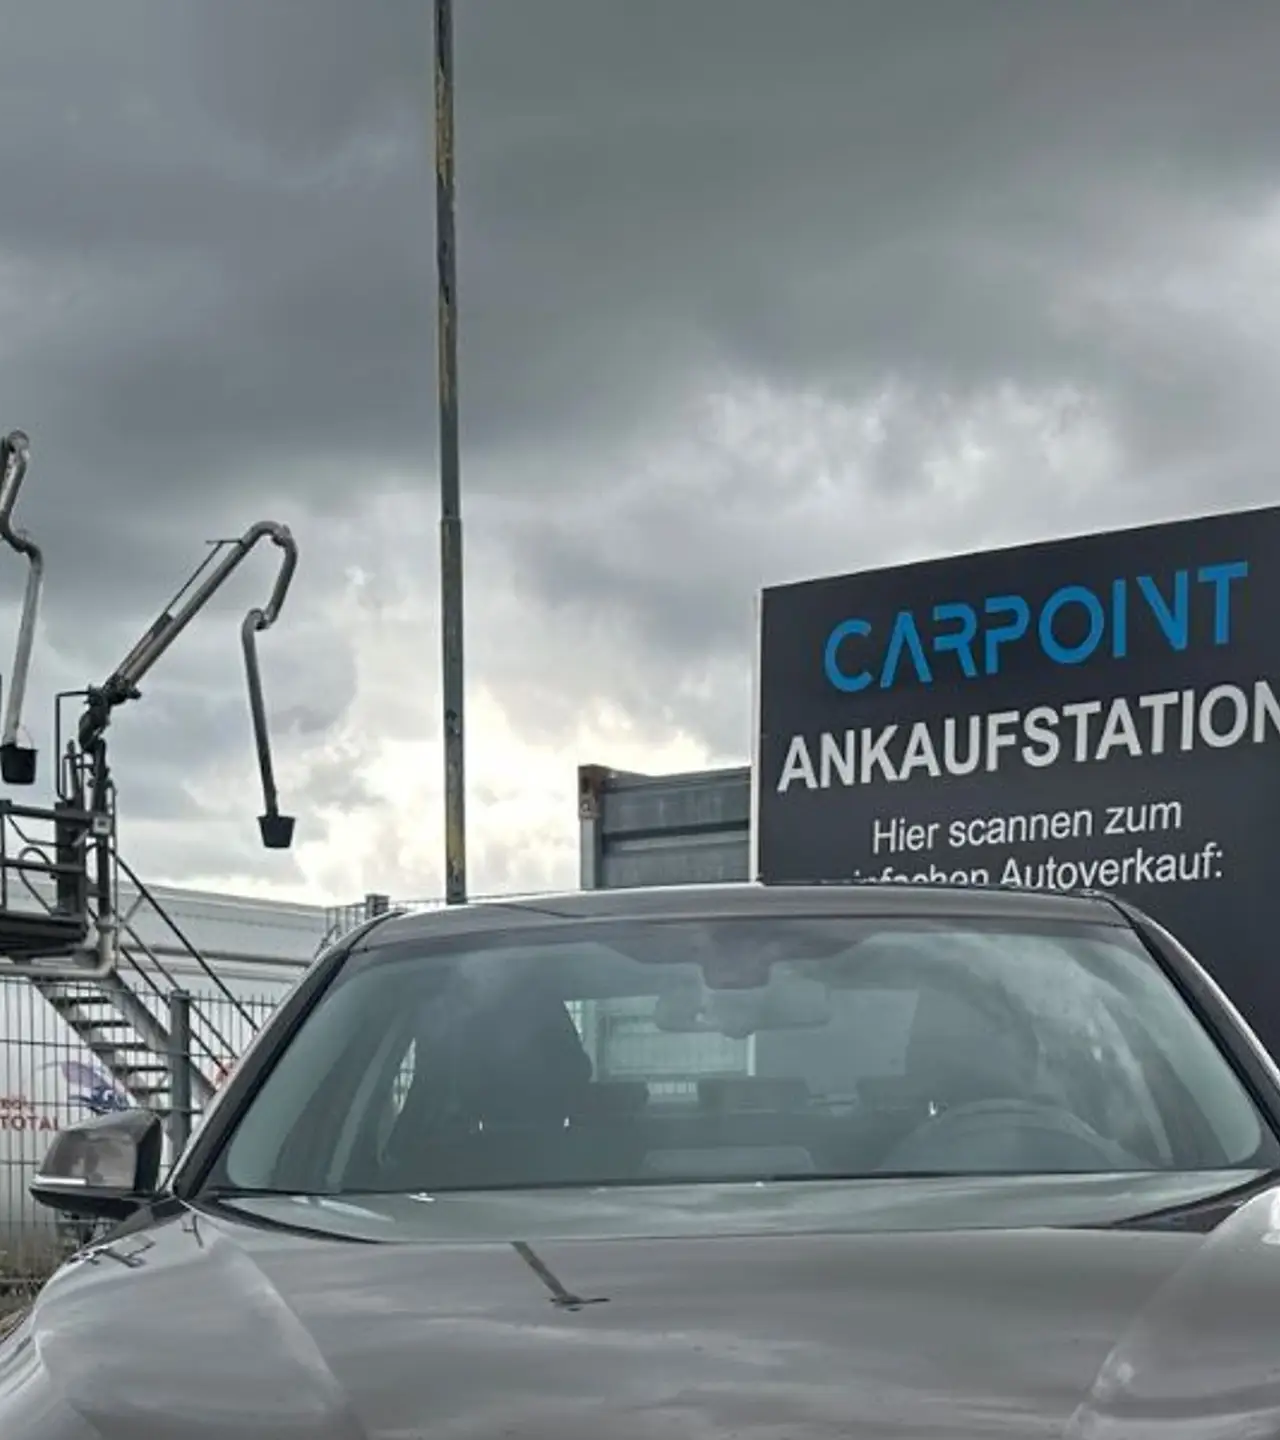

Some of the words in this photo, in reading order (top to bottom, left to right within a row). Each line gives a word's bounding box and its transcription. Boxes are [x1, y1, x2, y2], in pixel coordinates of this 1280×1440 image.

[823, 561, 1249, 692] CARPOINT
[873, 816, 942, 855] Hier
[948, 808, 1094, 848] scannen
[1103, 801, 1183, 835] zum
[999, 841, 1223, 890] Autoverkauf:
